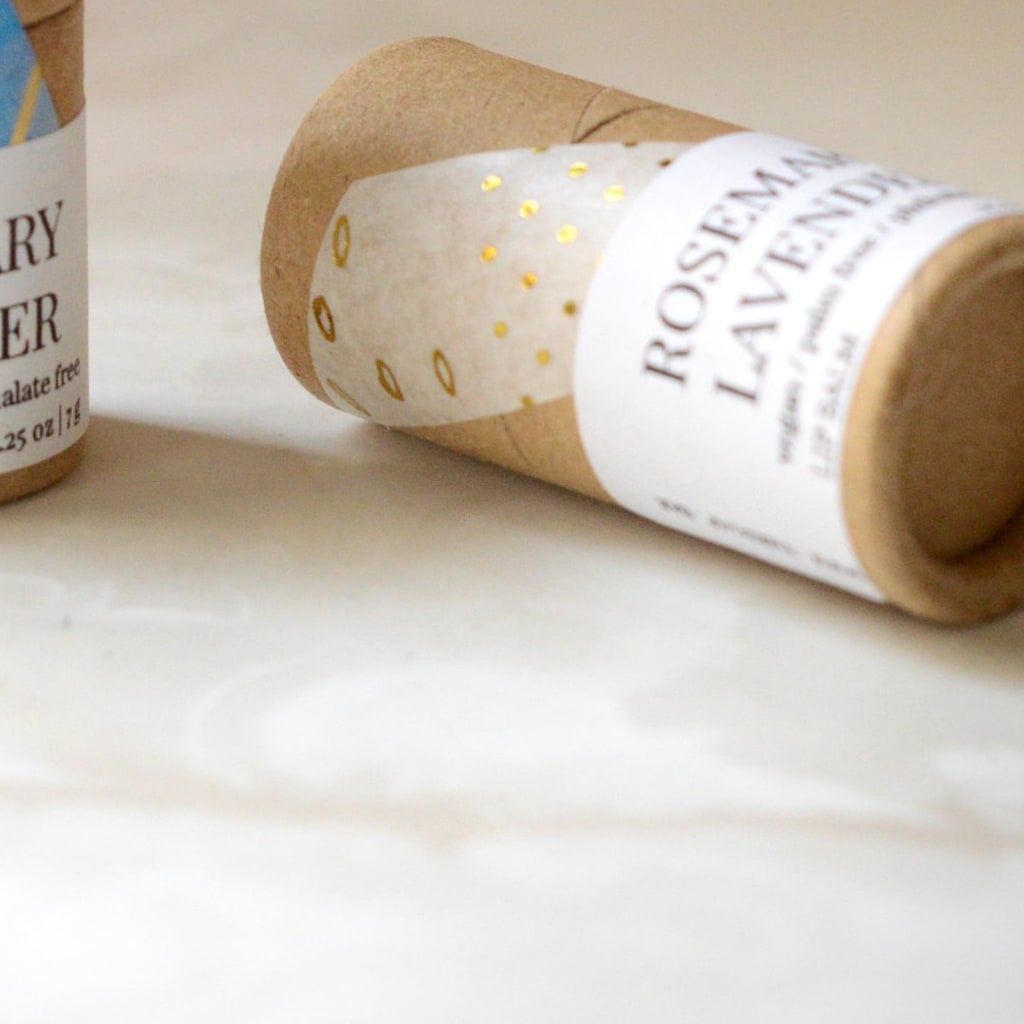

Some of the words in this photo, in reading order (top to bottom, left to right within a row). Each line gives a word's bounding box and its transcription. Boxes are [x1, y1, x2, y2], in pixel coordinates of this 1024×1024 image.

[641, 149, 846, 389] ROSEMAR
[711, 170, 921, 406] LAVENDE
[32, 417, 54, 442] oz
[54, 357, 81, 390] free
